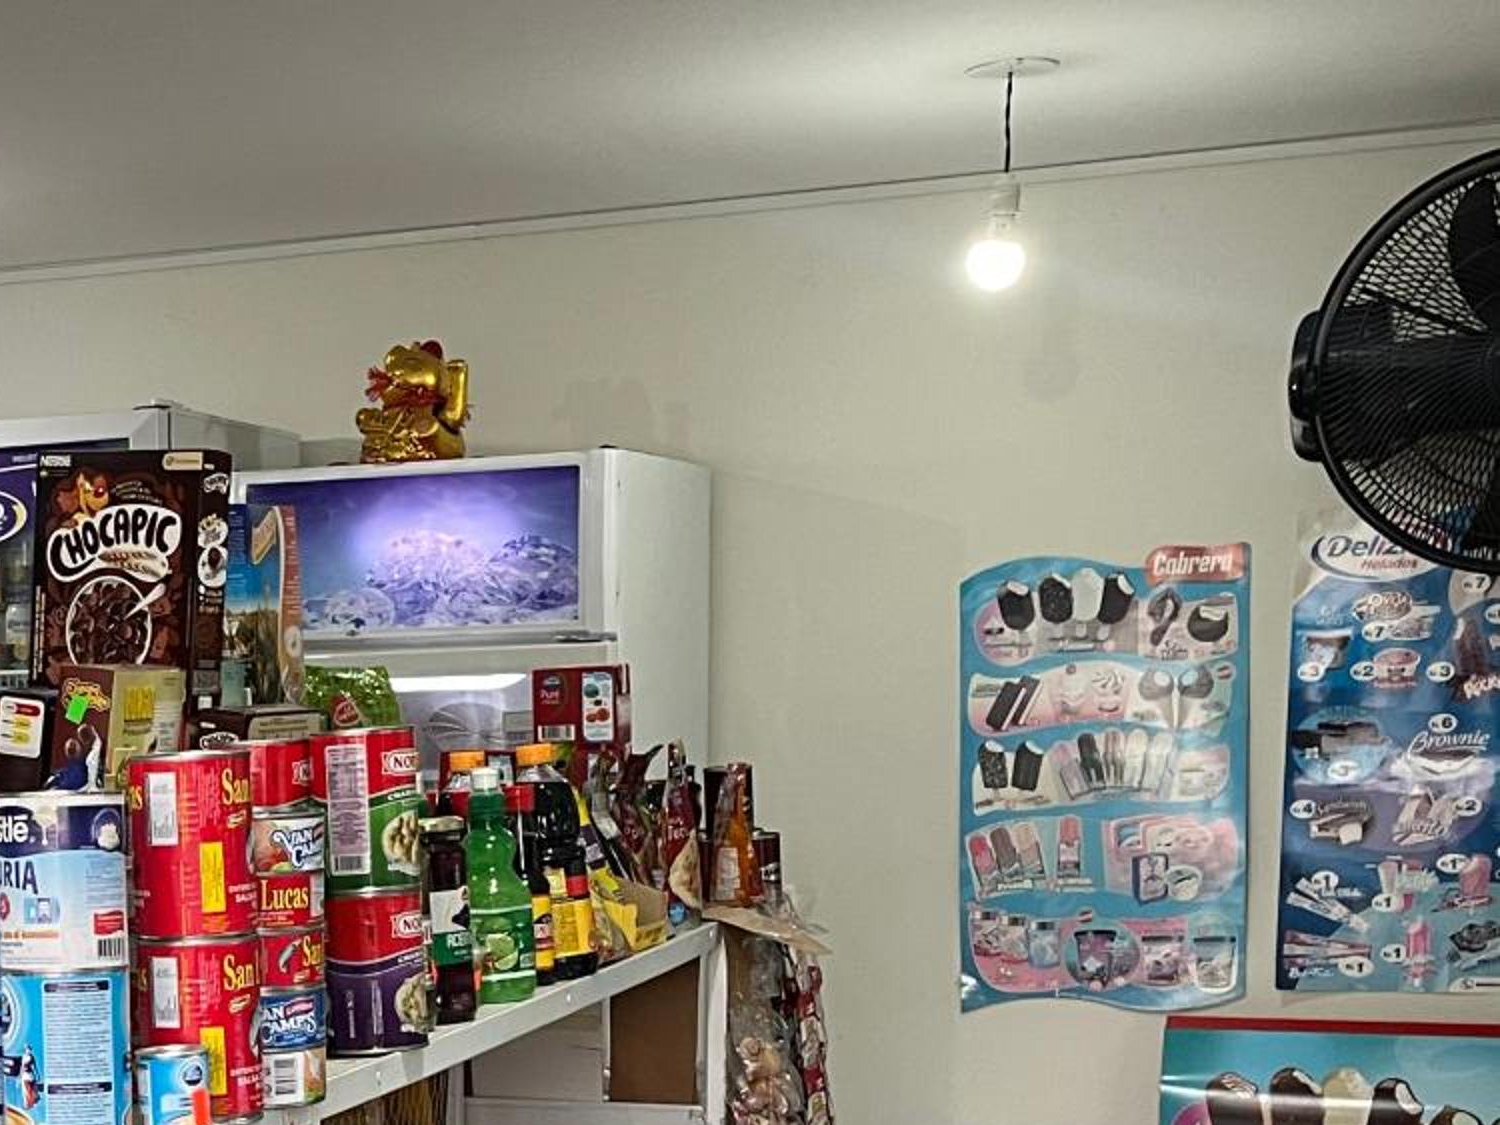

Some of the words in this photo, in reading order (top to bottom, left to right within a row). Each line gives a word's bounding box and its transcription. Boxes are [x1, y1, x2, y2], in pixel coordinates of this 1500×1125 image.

[49, 507, 179, 578] CHOCAPIC
[1326, 534, 1407, 558] Deliz
[1153, 550, 1234, 577] Cabrera
[0, 860, 39, 895] RIA
[260, 879, 310, 912] Lucas
